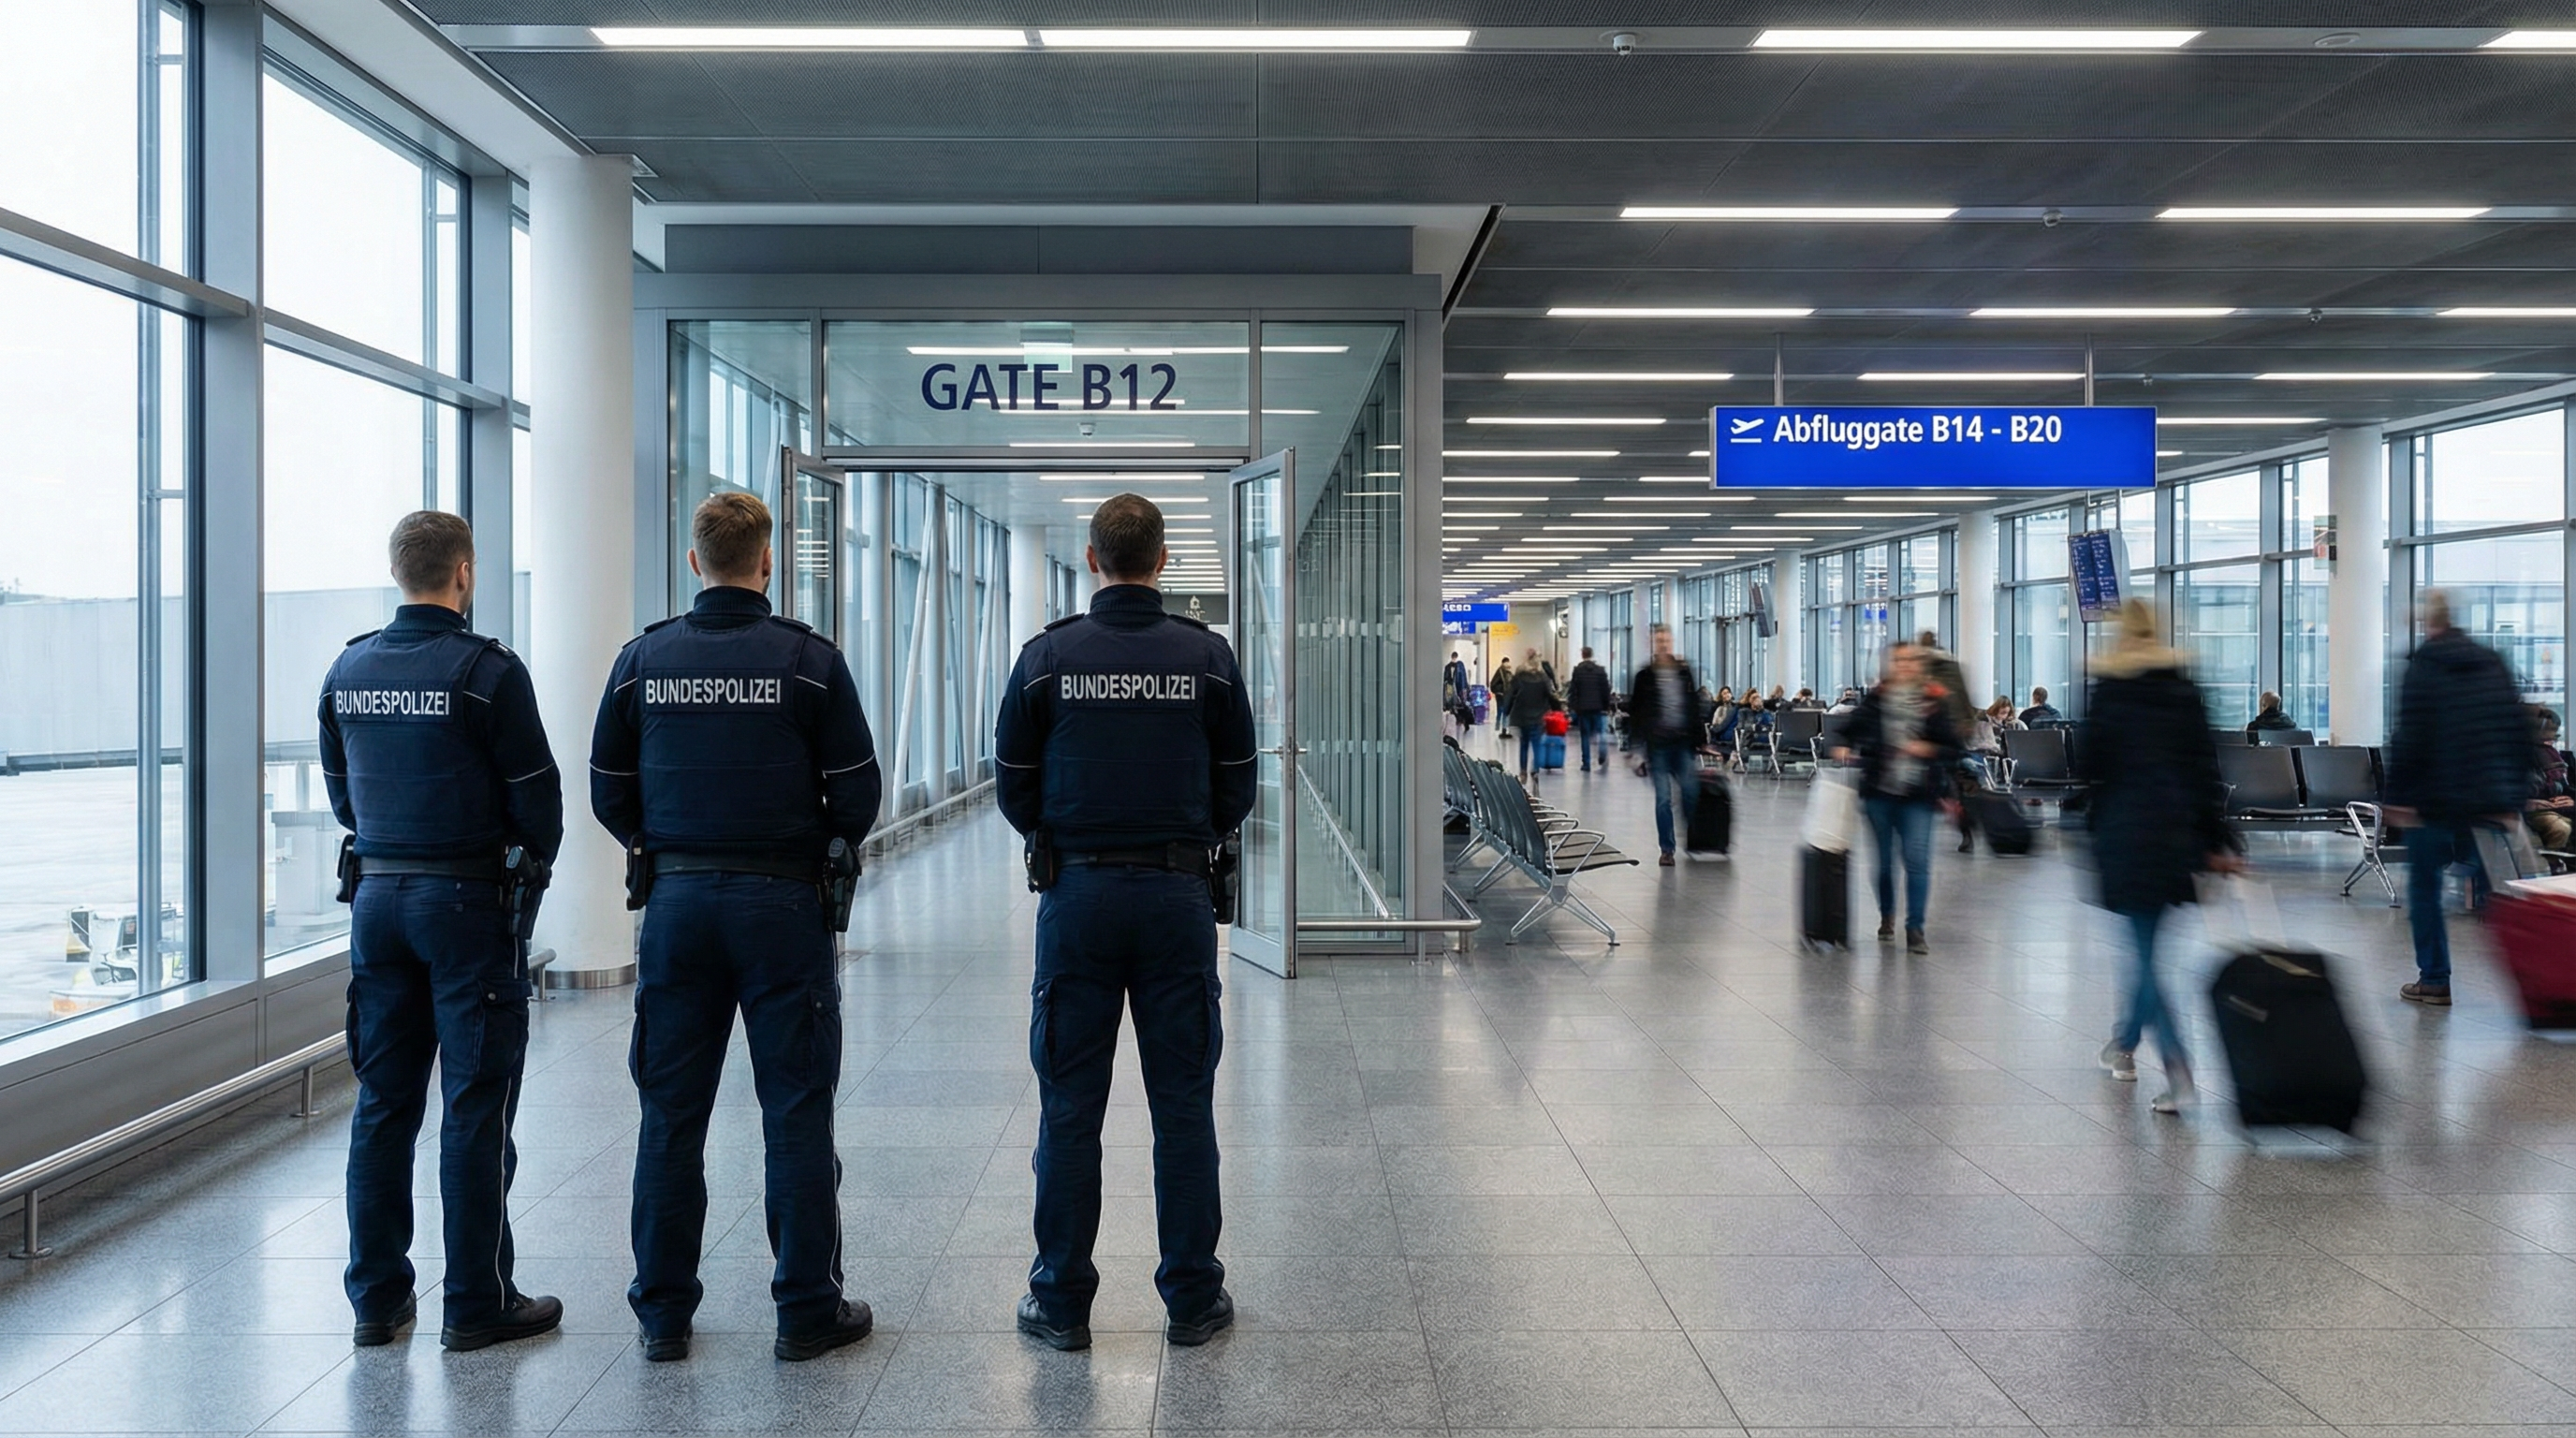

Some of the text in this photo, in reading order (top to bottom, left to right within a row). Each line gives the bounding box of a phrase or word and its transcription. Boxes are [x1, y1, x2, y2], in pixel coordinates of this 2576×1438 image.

[921, 362, 1178, 412] GATE B12
[1773, 415, 1924, 450] Abfluggate
[1933, 416, 1983, 443] B14
[2012, 416, 2062, 443] B20
[645, 677, 783, 705] BUNDESPOLIZEI
[1061, 673, 1197, 700] BUNDESPOLIZEI
[335, 690, 450, 717] BUNDESPOLIZEI
